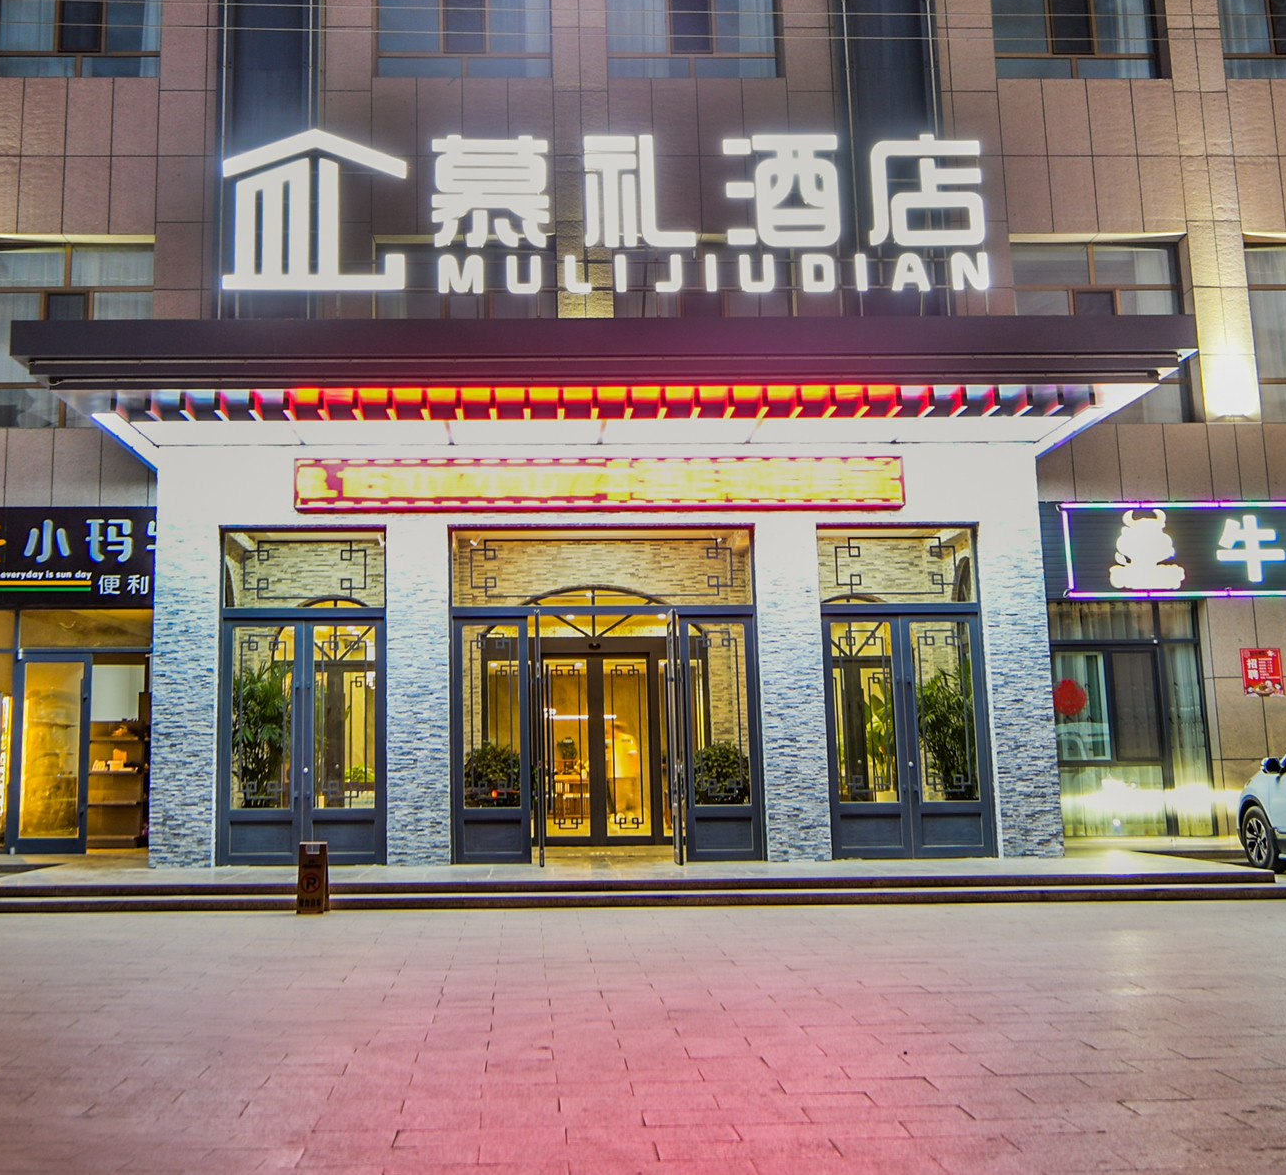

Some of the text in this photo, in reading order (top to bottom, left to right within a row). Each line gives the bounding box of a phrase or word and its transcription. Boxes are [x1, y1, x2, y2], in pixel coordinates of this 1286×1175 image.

[430, 134, 981, 248] 慕礼酒店
[0, 570, 92, 581] everyday is sun day
[98, 575, 150, 595] 便利
[1246, 658, 1259, 680] 招聘
